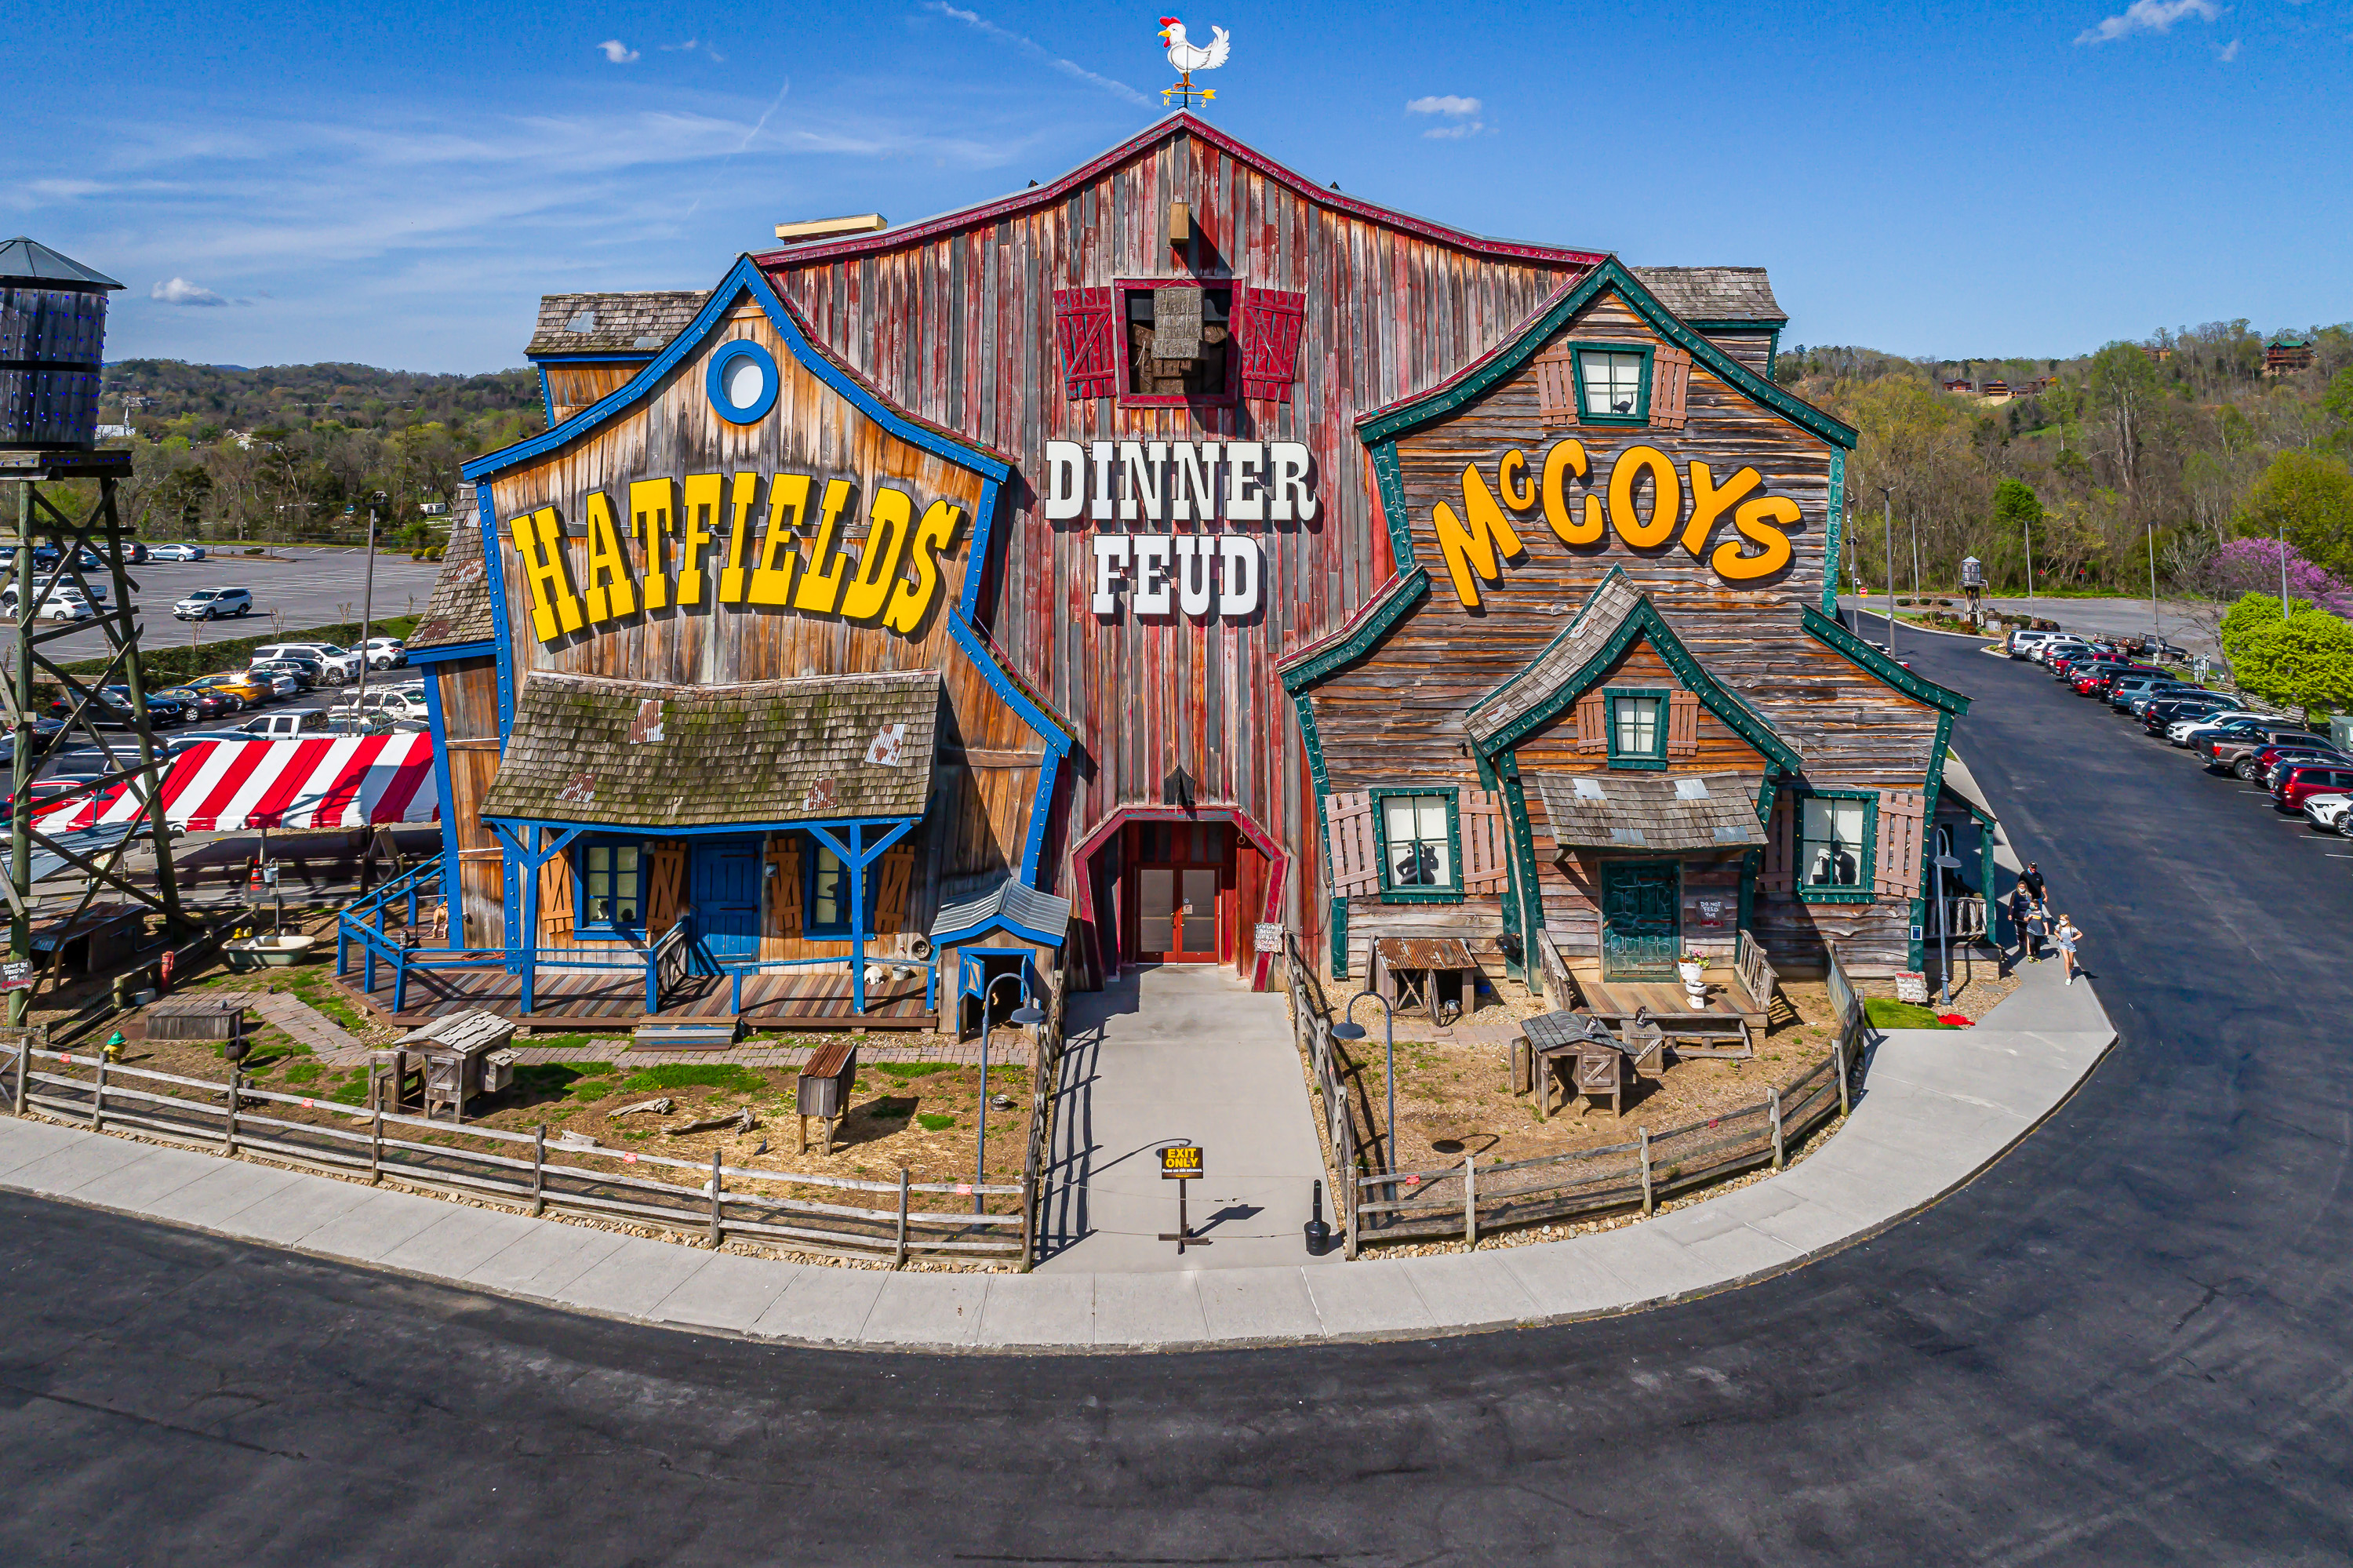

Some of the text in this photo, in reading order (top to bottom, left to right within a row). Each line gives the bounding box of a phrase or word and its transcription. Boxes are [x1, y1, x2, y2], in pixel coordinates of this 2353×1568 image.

[1045, 440, 1316, 521] DINNER
[509, 471, 962, 643] HATFIELDS
[1092, 534, 1258, 616] FEUD
[1166, 1157, 1198, 1168] ONLY
[1167, 1148, 1197, 1159] EXIT
